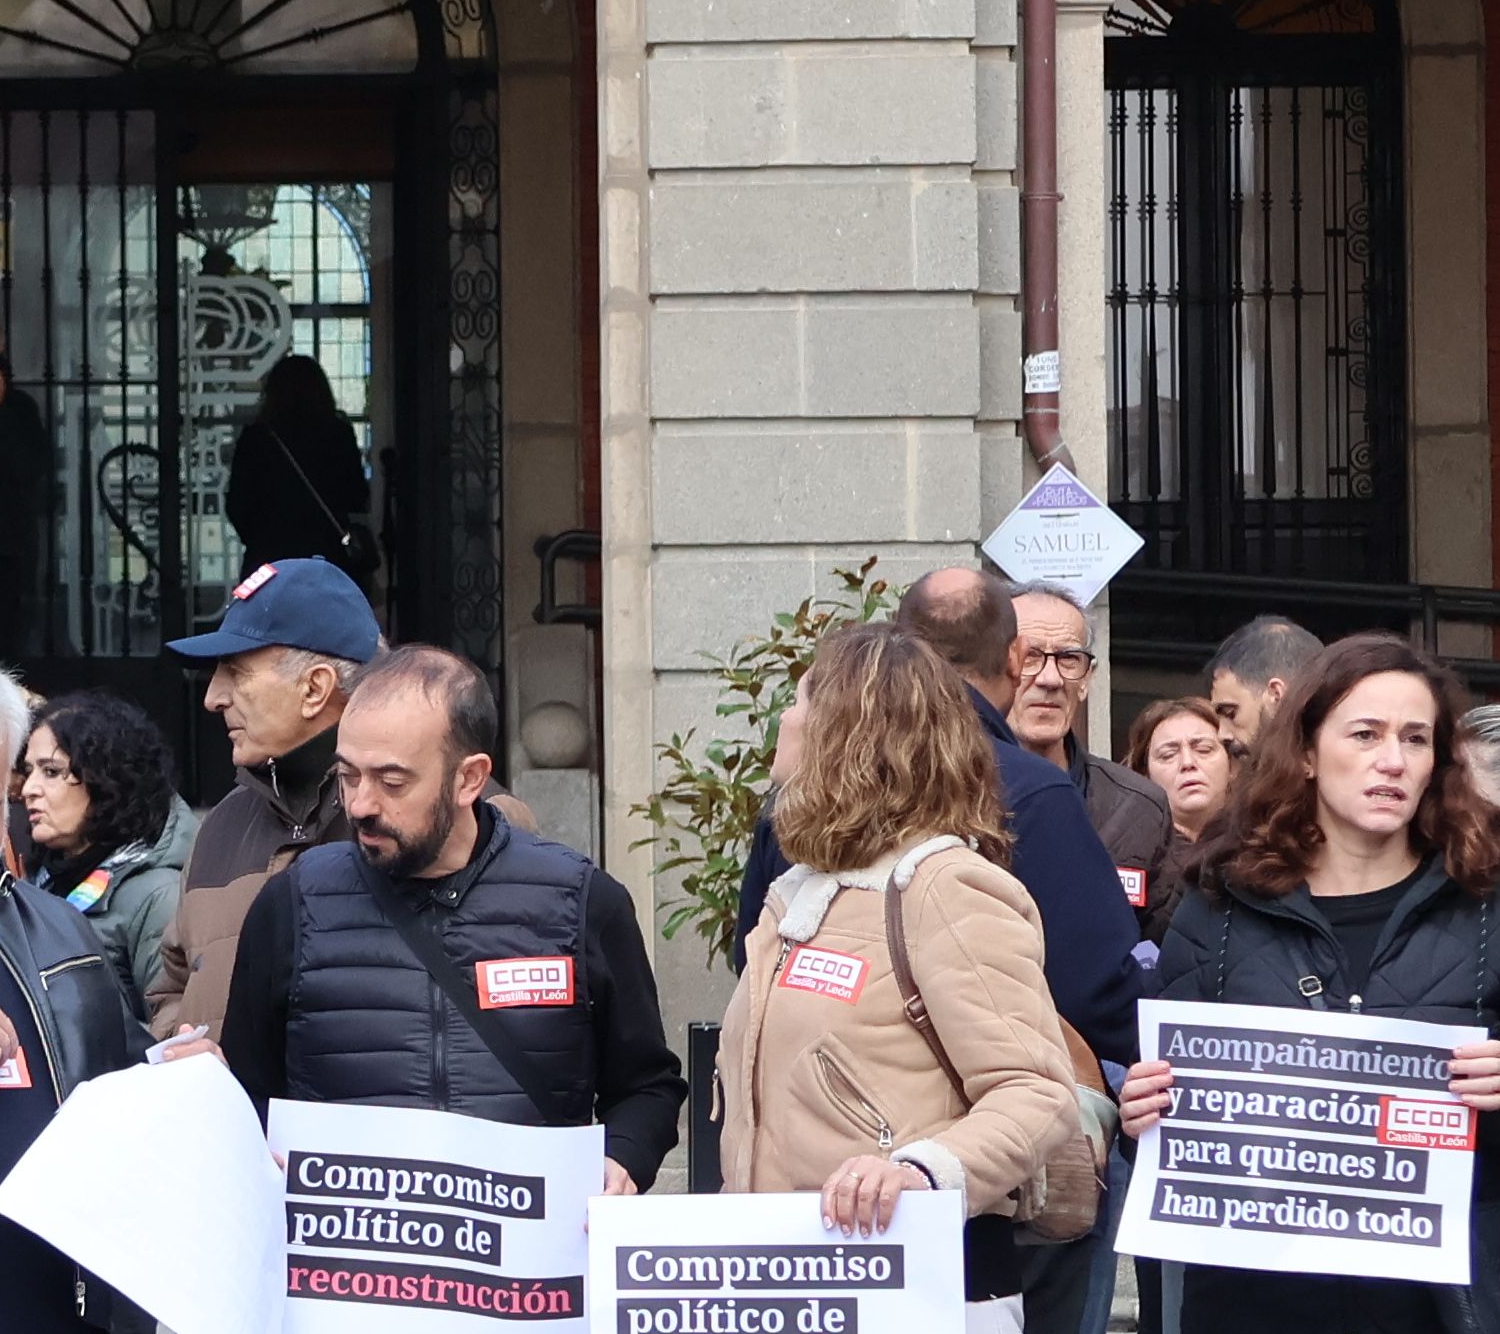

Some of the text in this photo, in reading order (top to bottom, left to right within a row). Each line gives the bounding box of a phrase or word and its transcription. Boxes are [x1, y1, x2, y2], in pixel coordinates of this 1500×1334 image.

[1014, 532, 1110, 554] SAMUEL
[494, 968, 560, 985] CCOO
[798, 956, 853, 979] CCOO
[489, 989, 568, 1003] Castilla y León
[786, 976, 816, 987] Castilla
[826, 983, 852, 998] León
[1165, 1029, 1454, 1081] Acompañamiento
[1167, 1086, 1381, 1126] y reparación
[1395, 1108, 1461, 1128] CCOO
[1386, 1131, 1468, 1147] Castilla y León
[1166, 1136, 1417, 1183] para quienes lo
[298, 1157, 532, 1211] Compromiso
[292, 1208, 492, 1255] político de
[1160, 1186, 1434, 1240] han perdido todo
[626, 1247, 892, 1289] Compromiso
[288, 1265, 572, 1315] reconstrucción
[796, 1300, 845, 1334] de
